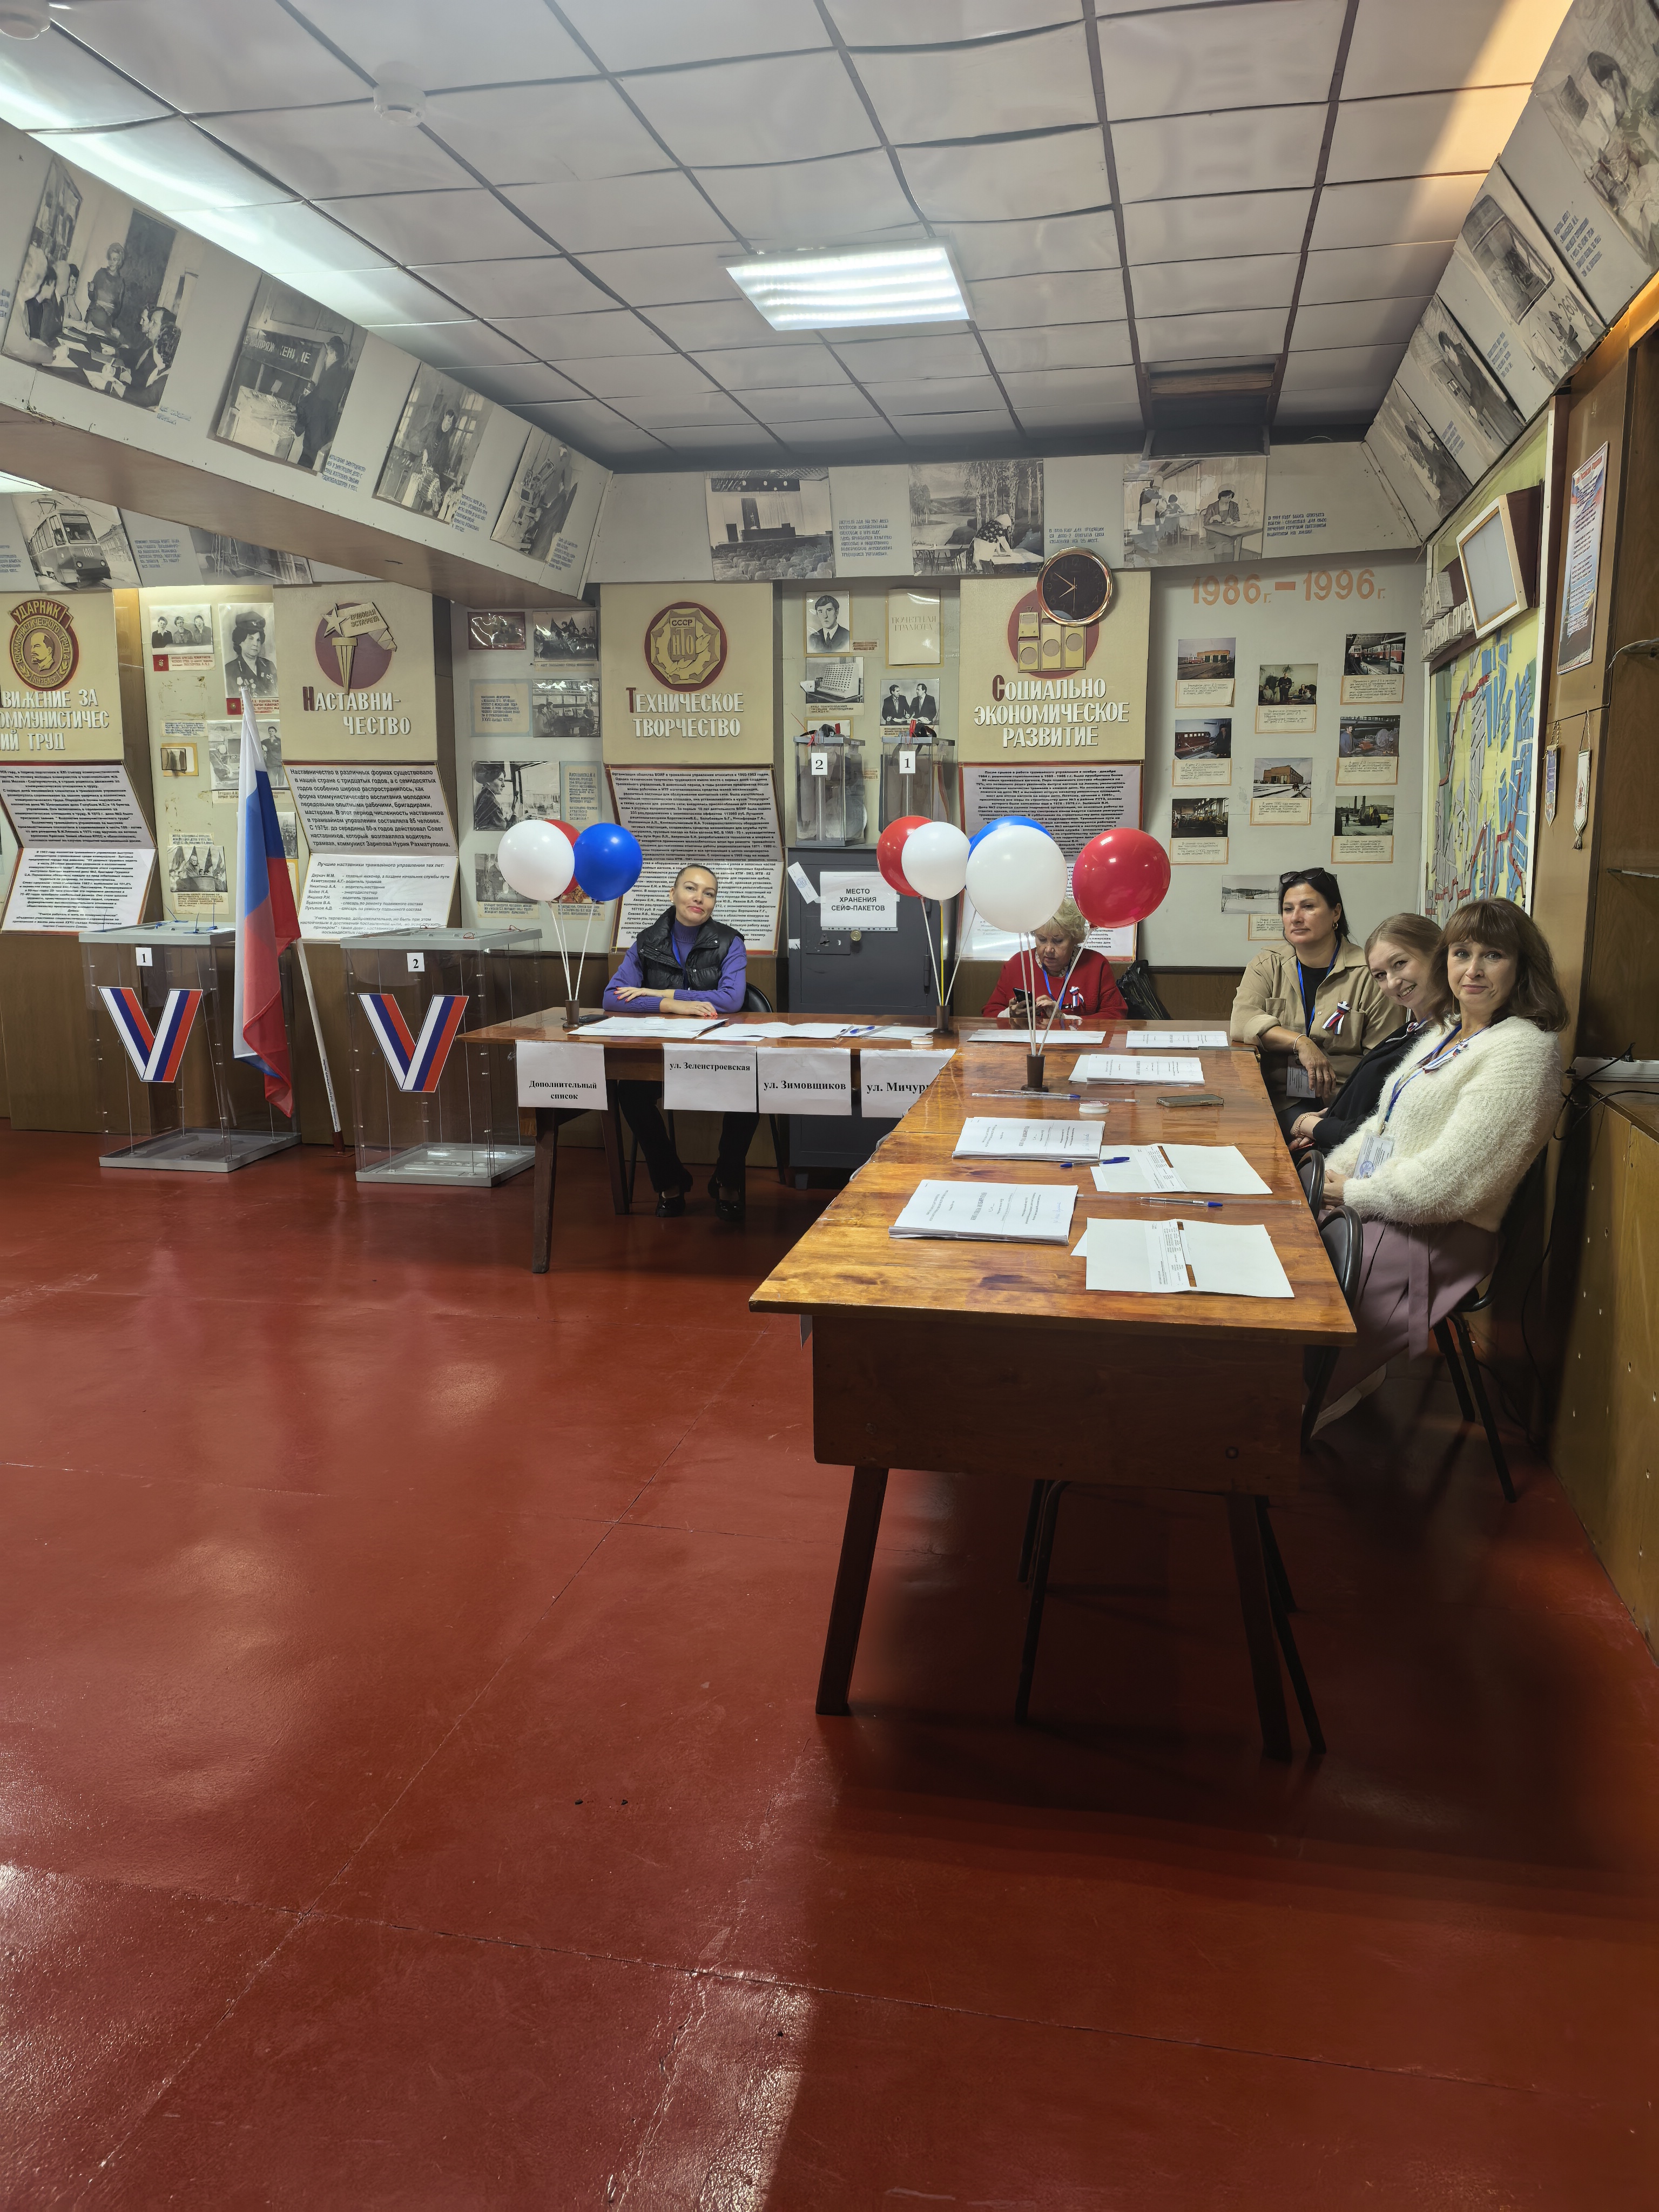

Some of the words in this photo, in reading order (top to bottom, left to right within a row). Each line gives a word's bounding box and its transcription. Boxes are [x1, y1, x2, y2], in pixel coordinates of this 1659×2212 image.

[13, 601, 61, 622] УДАРНИК
[350, 609, 376, 621] ТРУДОВАЯ
[350, 616, 380, 628] ЭСТАФЕТА
[894, 623, 933, 631] ГРАМОТА
[14, 617, 60, 664] КОММУНИСТИЧЕСКОГО
[59, 632, 70, 660] ТРУДА
[993, 675, 1107, 702] СОЦИАЛЬНО
[0, 690, 71, 709] ВИЖЕНИЕ
[78, 689, 98, 706] ЗА
[626, 687, 744, 713] ТЕХНИЧЕСКОЕ
[0, 710, 109, 729] ОММУНИСТИЧЕС
[974, 702, 1130, 726] ЭКОНОМИЧЕСКОЕ
[343, 716, 412, 735] ЧЕСТВО
[632, 718, 740, 738] ТВОРЧЕСТВО
[0, 729, 19, 751] ИЙ
[28, 732, 65, 751] ТРУД
[1003, 725, 1098, 748] РАЗВИТИЕ
[815, 760, 823, 770] 2
[905, 758, 911, 768] 1
[142, 954, 146, 963] 1
[413, 959, 419, 969] 2
[670, 1062, 682, 1070] ул.
[683, 1062, 751, 1071] Зеленстроевская
[529, 1080, 597, 1090] Дополнительный
[764, 1081, 778, 1090] ул.
[781, 1080, 846, 1090] Зимовщиков
[867, 1084, 883, 1094] ул.
[550, 1092, 578, 1101] список
